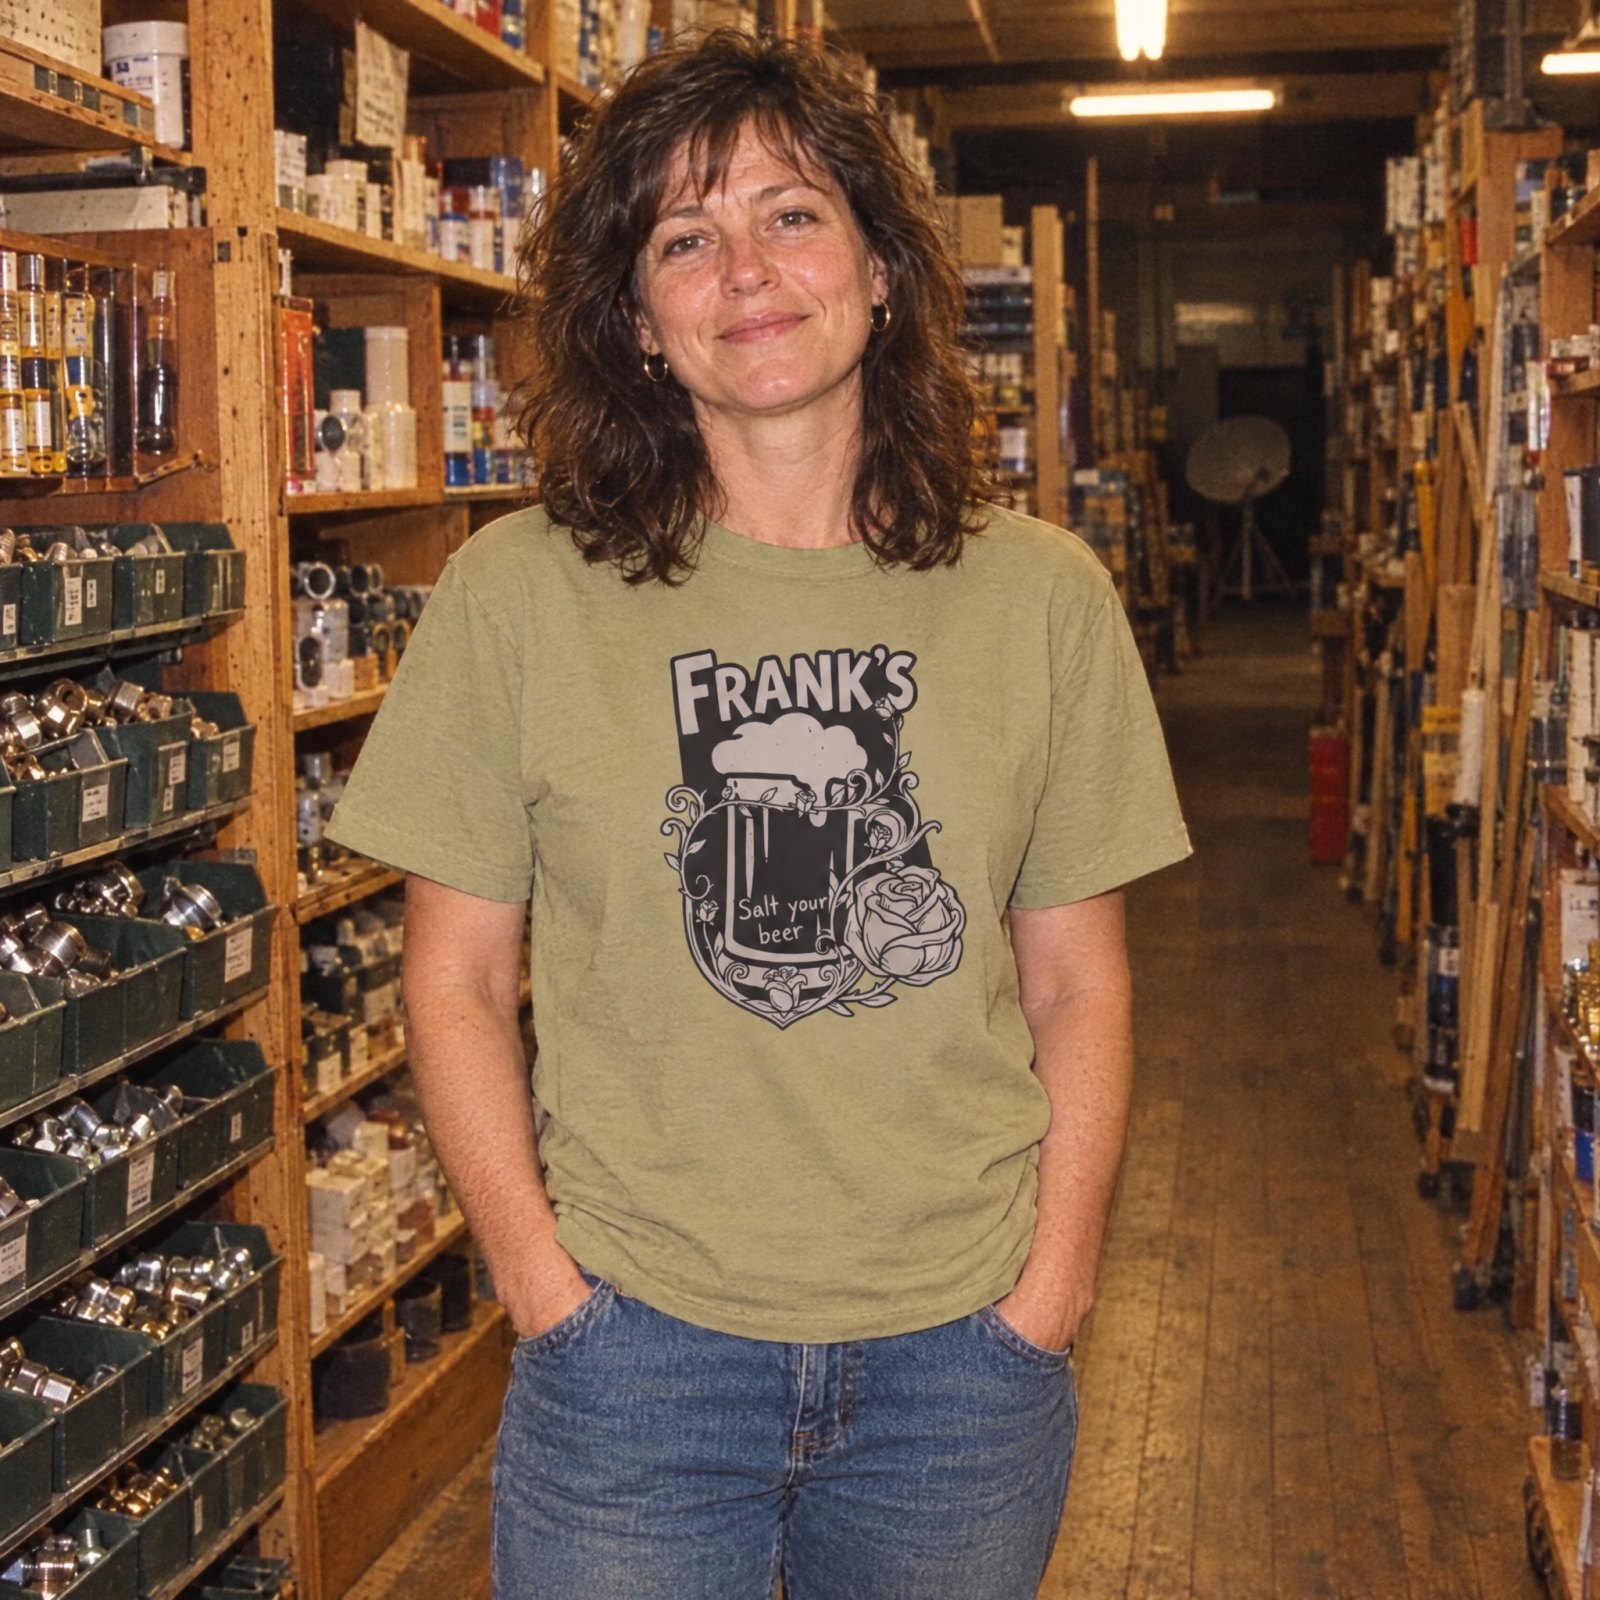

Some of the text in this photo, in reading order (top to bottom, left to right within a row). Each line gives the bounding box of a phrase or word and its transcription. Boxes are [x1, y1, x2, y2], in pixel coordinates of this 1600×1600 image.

[673, 647, 915, 736] FRANK'S
[738, 894, 828, 923] Salt your
[758, 922, 804, 945] beer
